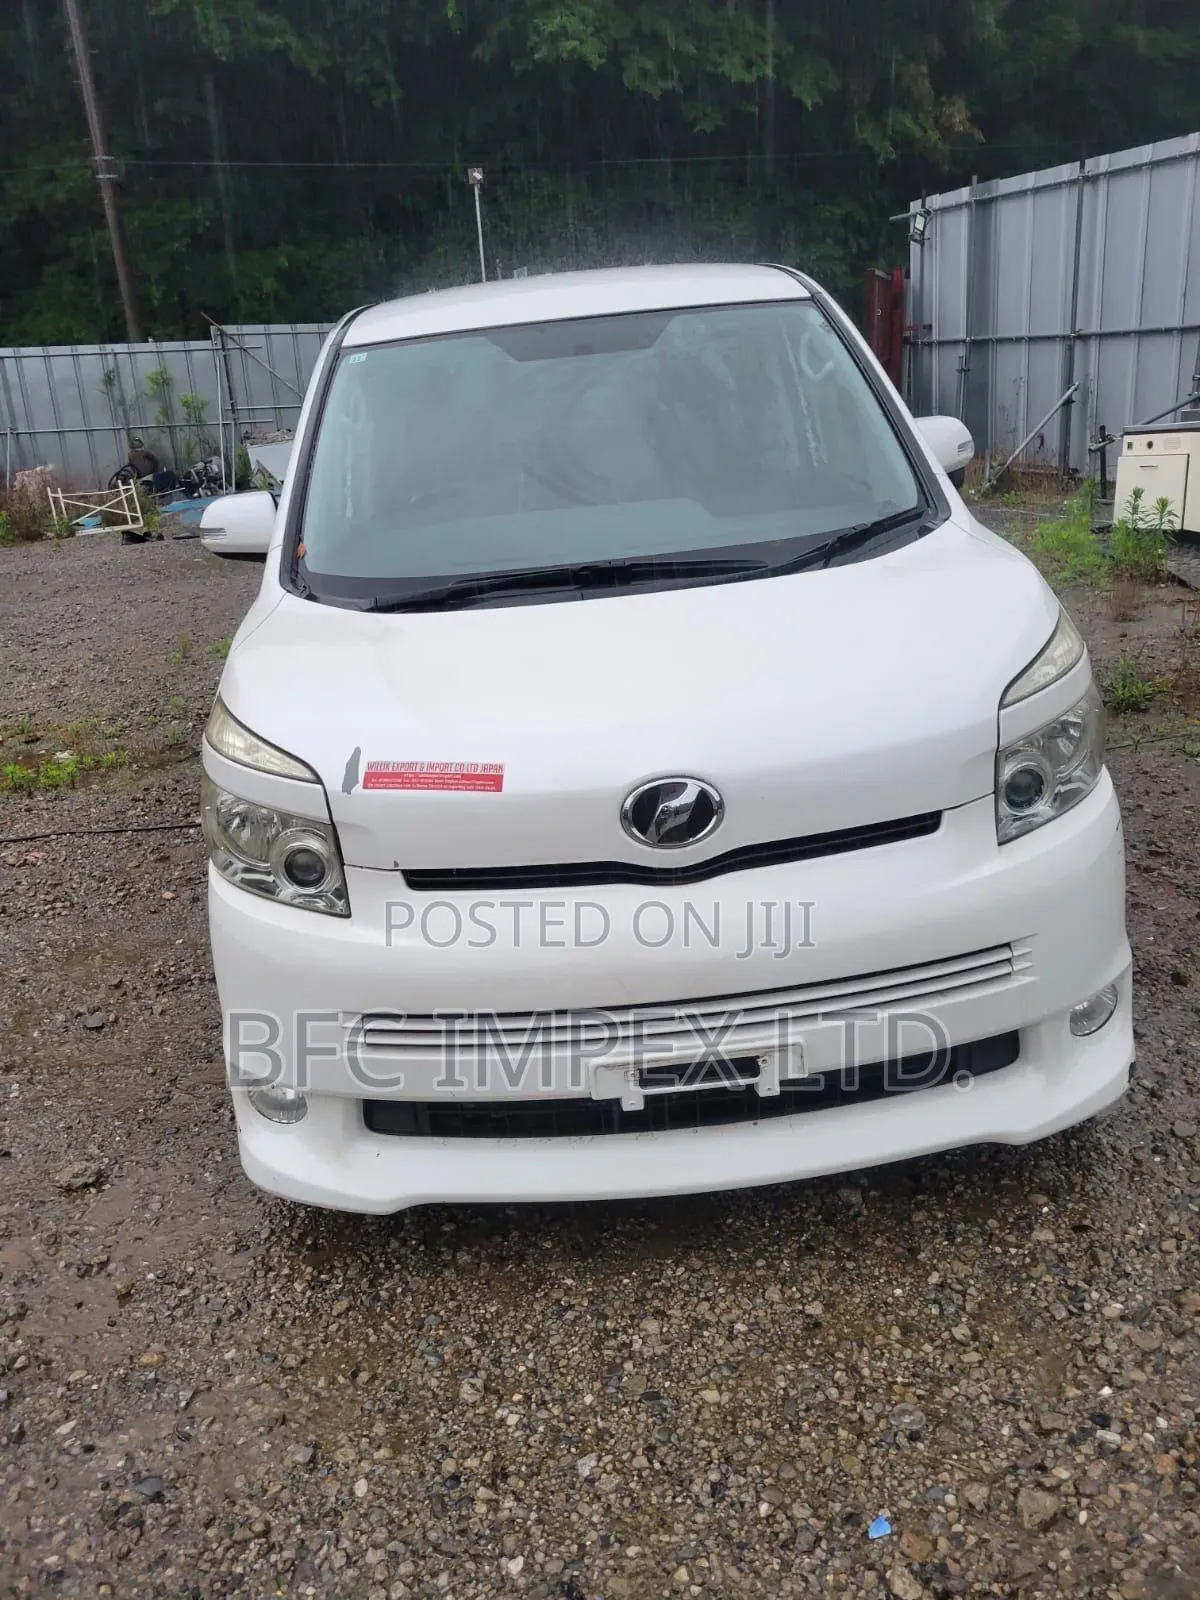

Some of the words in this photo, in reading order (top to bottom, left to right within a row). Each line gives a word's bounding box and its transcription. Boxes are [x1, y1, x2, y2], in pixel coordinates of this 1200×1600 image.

[391, 761, 418, 771] EXPORT
[419, 762, 425, 771] &
[426, 761, 454, 772] IMPORT
[454, 762, 465, 772] CO
[466, 763, 479, 773] LTD
[480, 763, 504, 774] JAPAN
